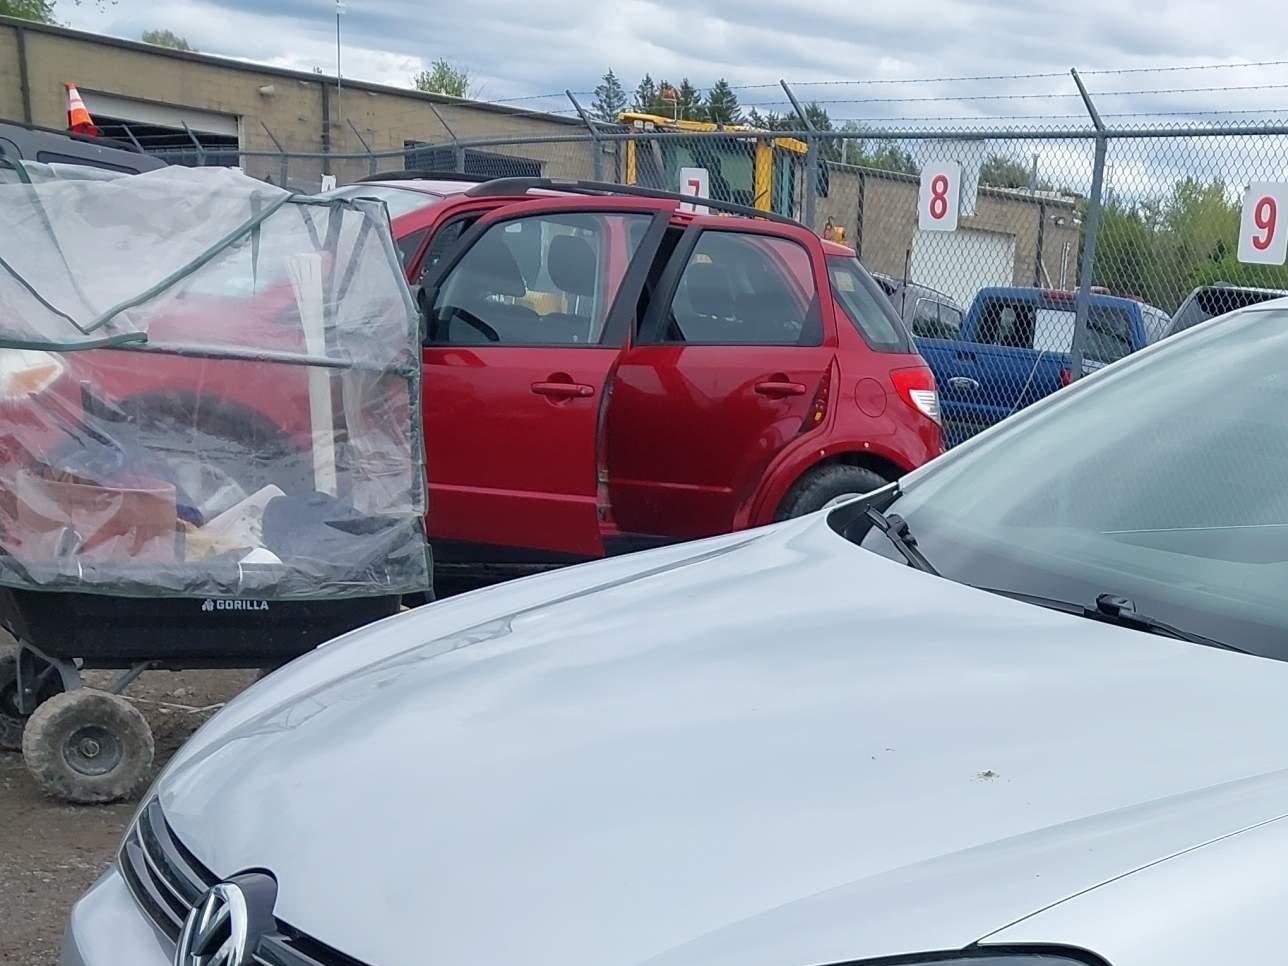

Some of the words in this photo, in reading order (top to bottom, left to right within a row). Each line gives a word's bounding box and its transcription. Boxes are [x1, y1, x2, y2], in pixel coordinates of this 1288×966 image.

[687, 179, 700, 213] 7
[929, 174, 949, 220] 8
[1251, 195, 1278, 251] 9
[216, 599, 269, 611] GORILLA
